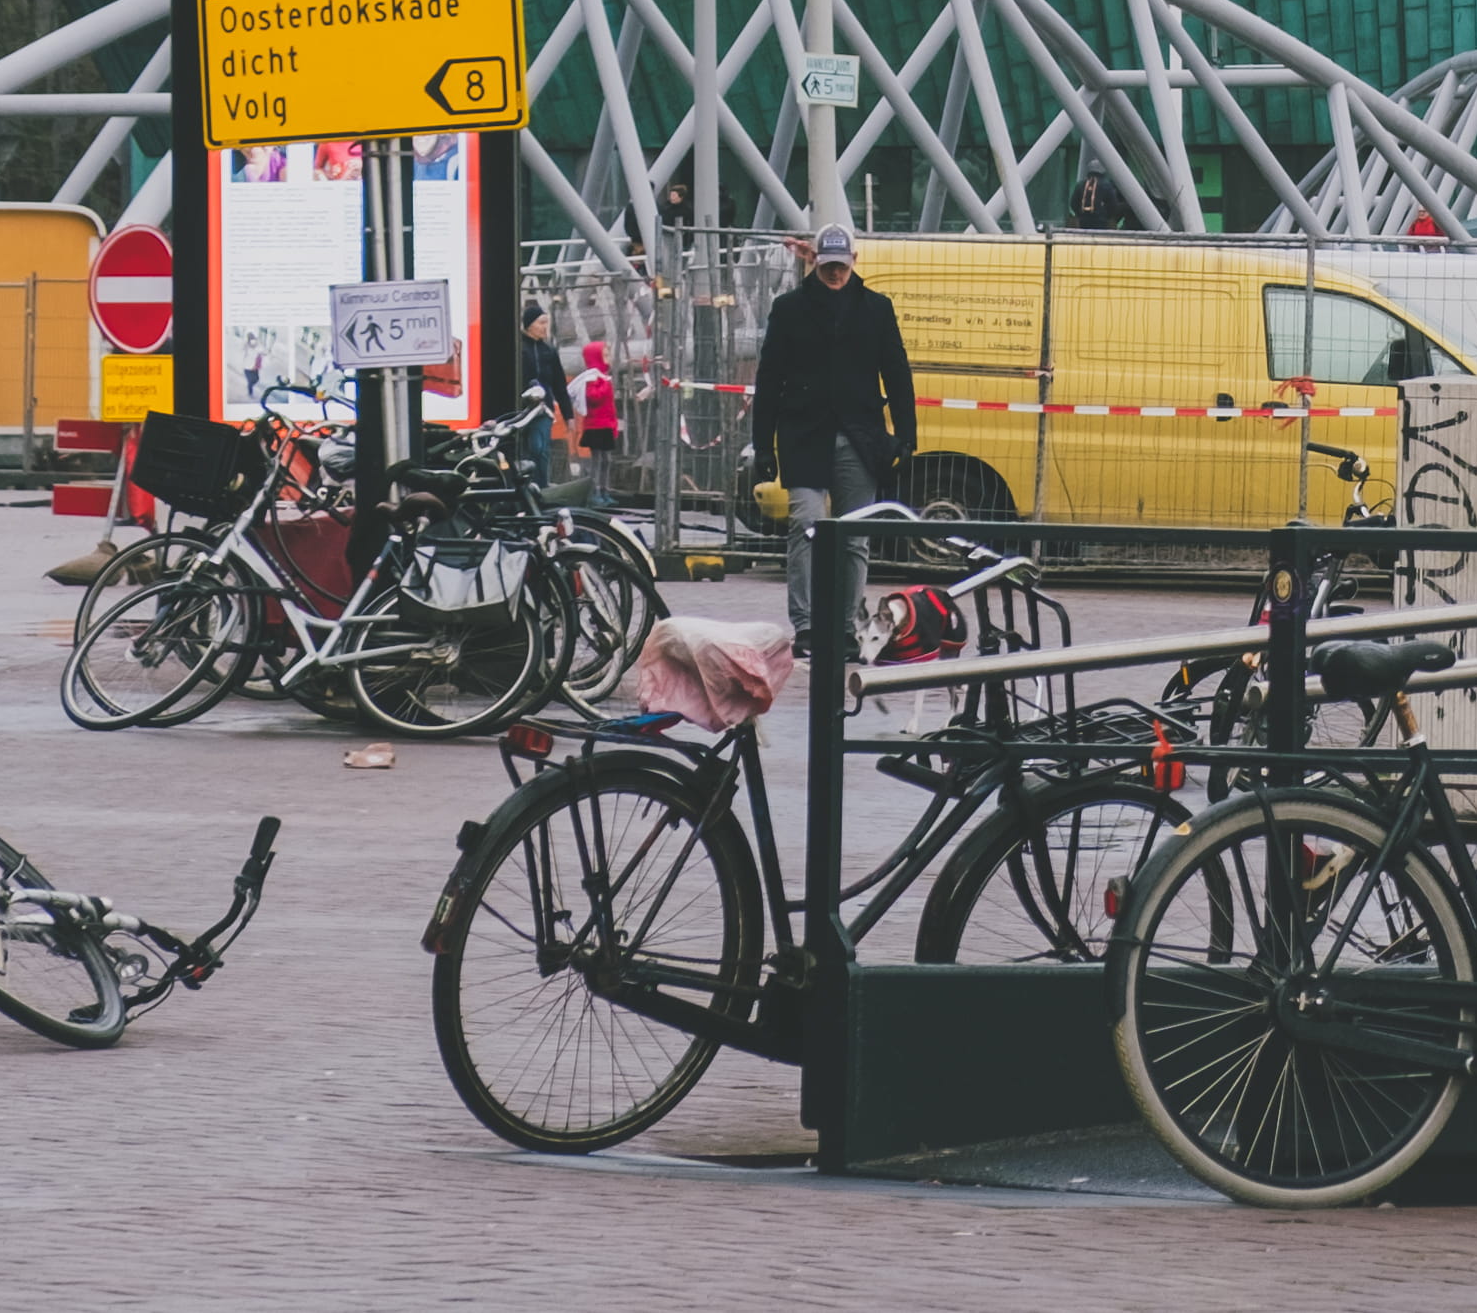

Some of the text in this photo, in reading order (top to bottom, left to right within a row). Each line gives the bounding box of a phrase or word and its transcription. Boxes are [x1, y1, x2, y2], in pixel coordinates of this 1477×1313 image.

[222, 46, 299, 77] dicht
[465, 70, 485, 102] 8
[824, 78, 833, 95] 5
[223, 92, 287, 127] Volg
[392, 288, 440, 302] Centraal
[389, 315, 438, 341] 5 min
[903, 313, 952, 325] Branding
